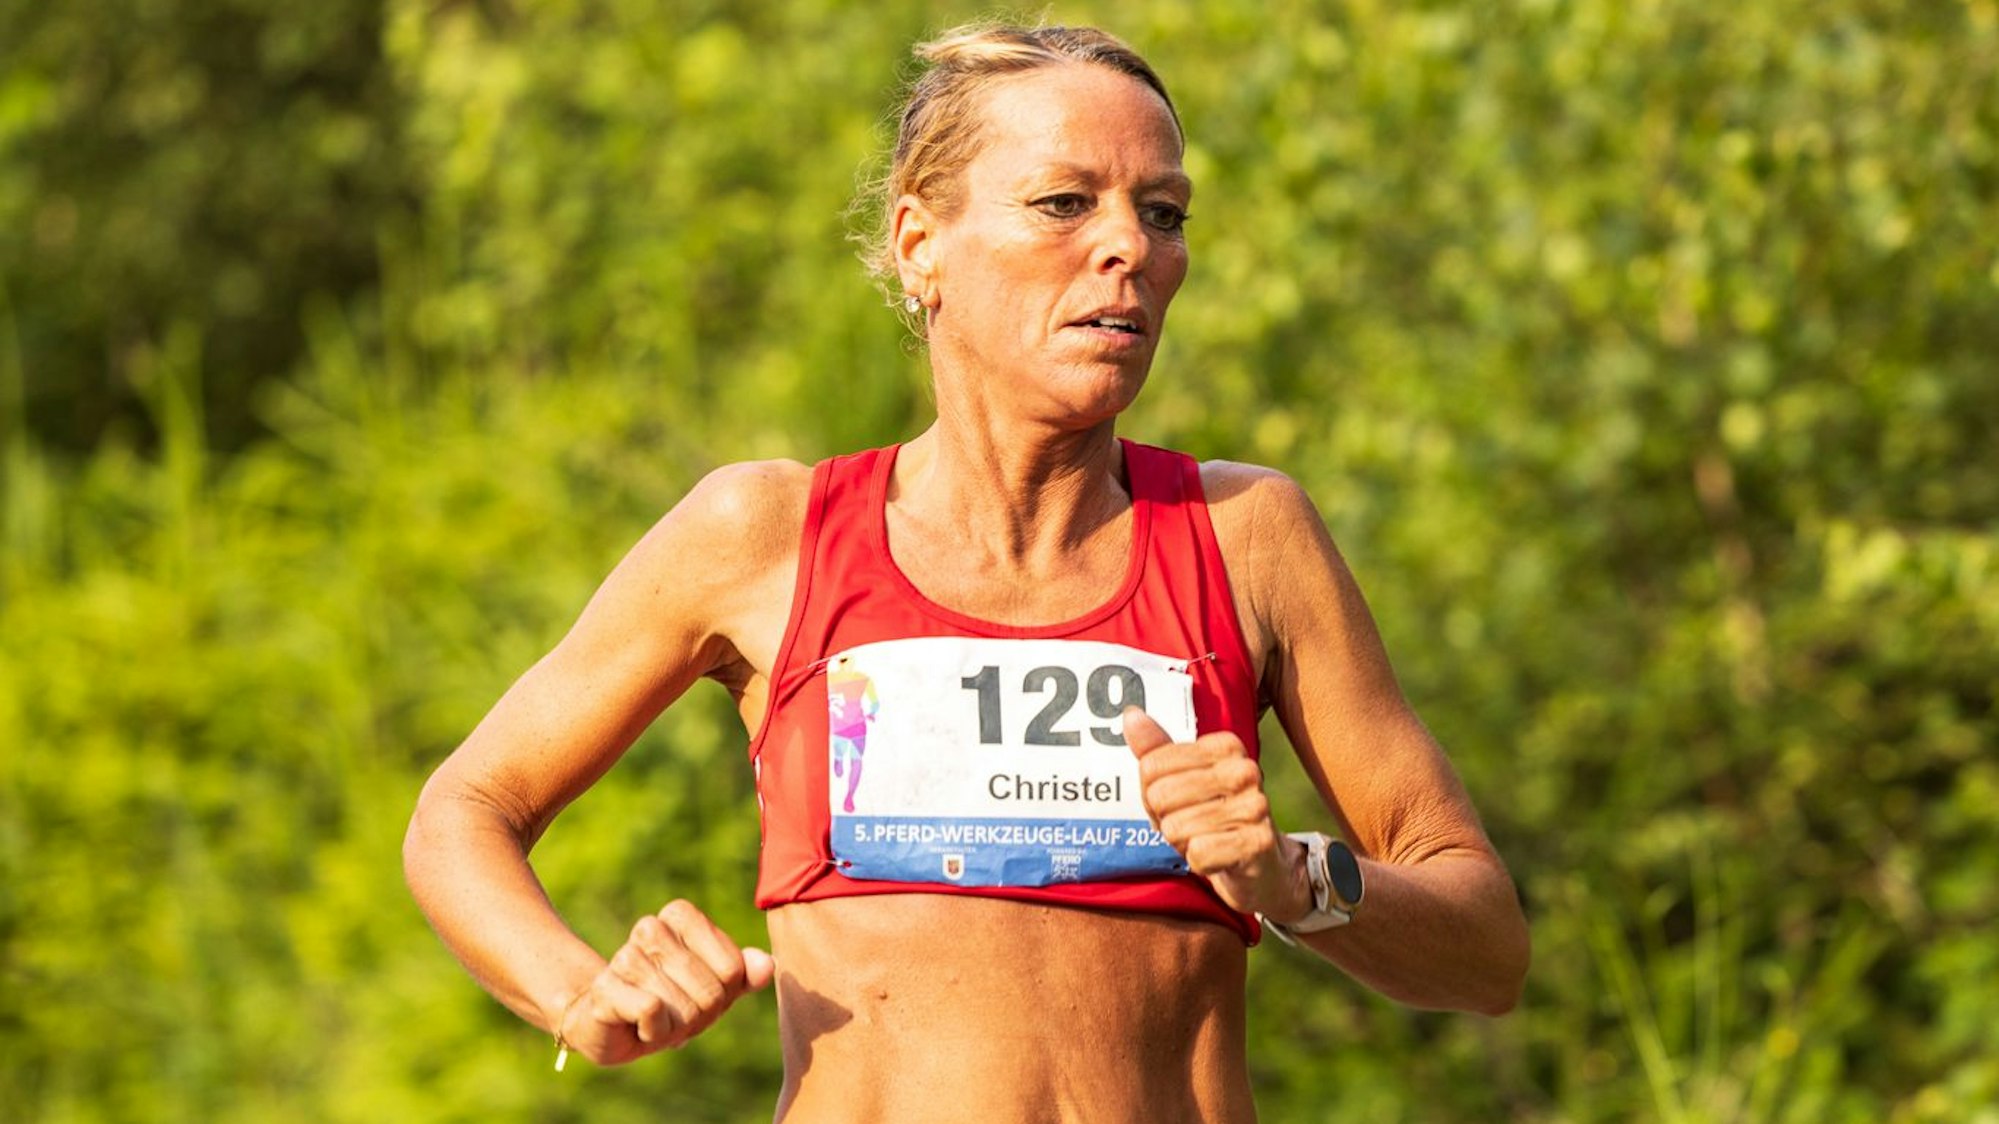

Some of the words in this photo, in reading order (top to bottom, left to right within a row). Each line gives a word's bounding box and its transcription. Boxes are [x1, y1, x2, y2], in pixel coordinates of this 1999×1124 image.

[961, 664, 1146, 747] 129
[988, 773, 1122, 802] Christel
[854, 823, 871, 842] 5.
[874, 824, 1121, 846] PFERD-WERKZEUGE-LAUF
